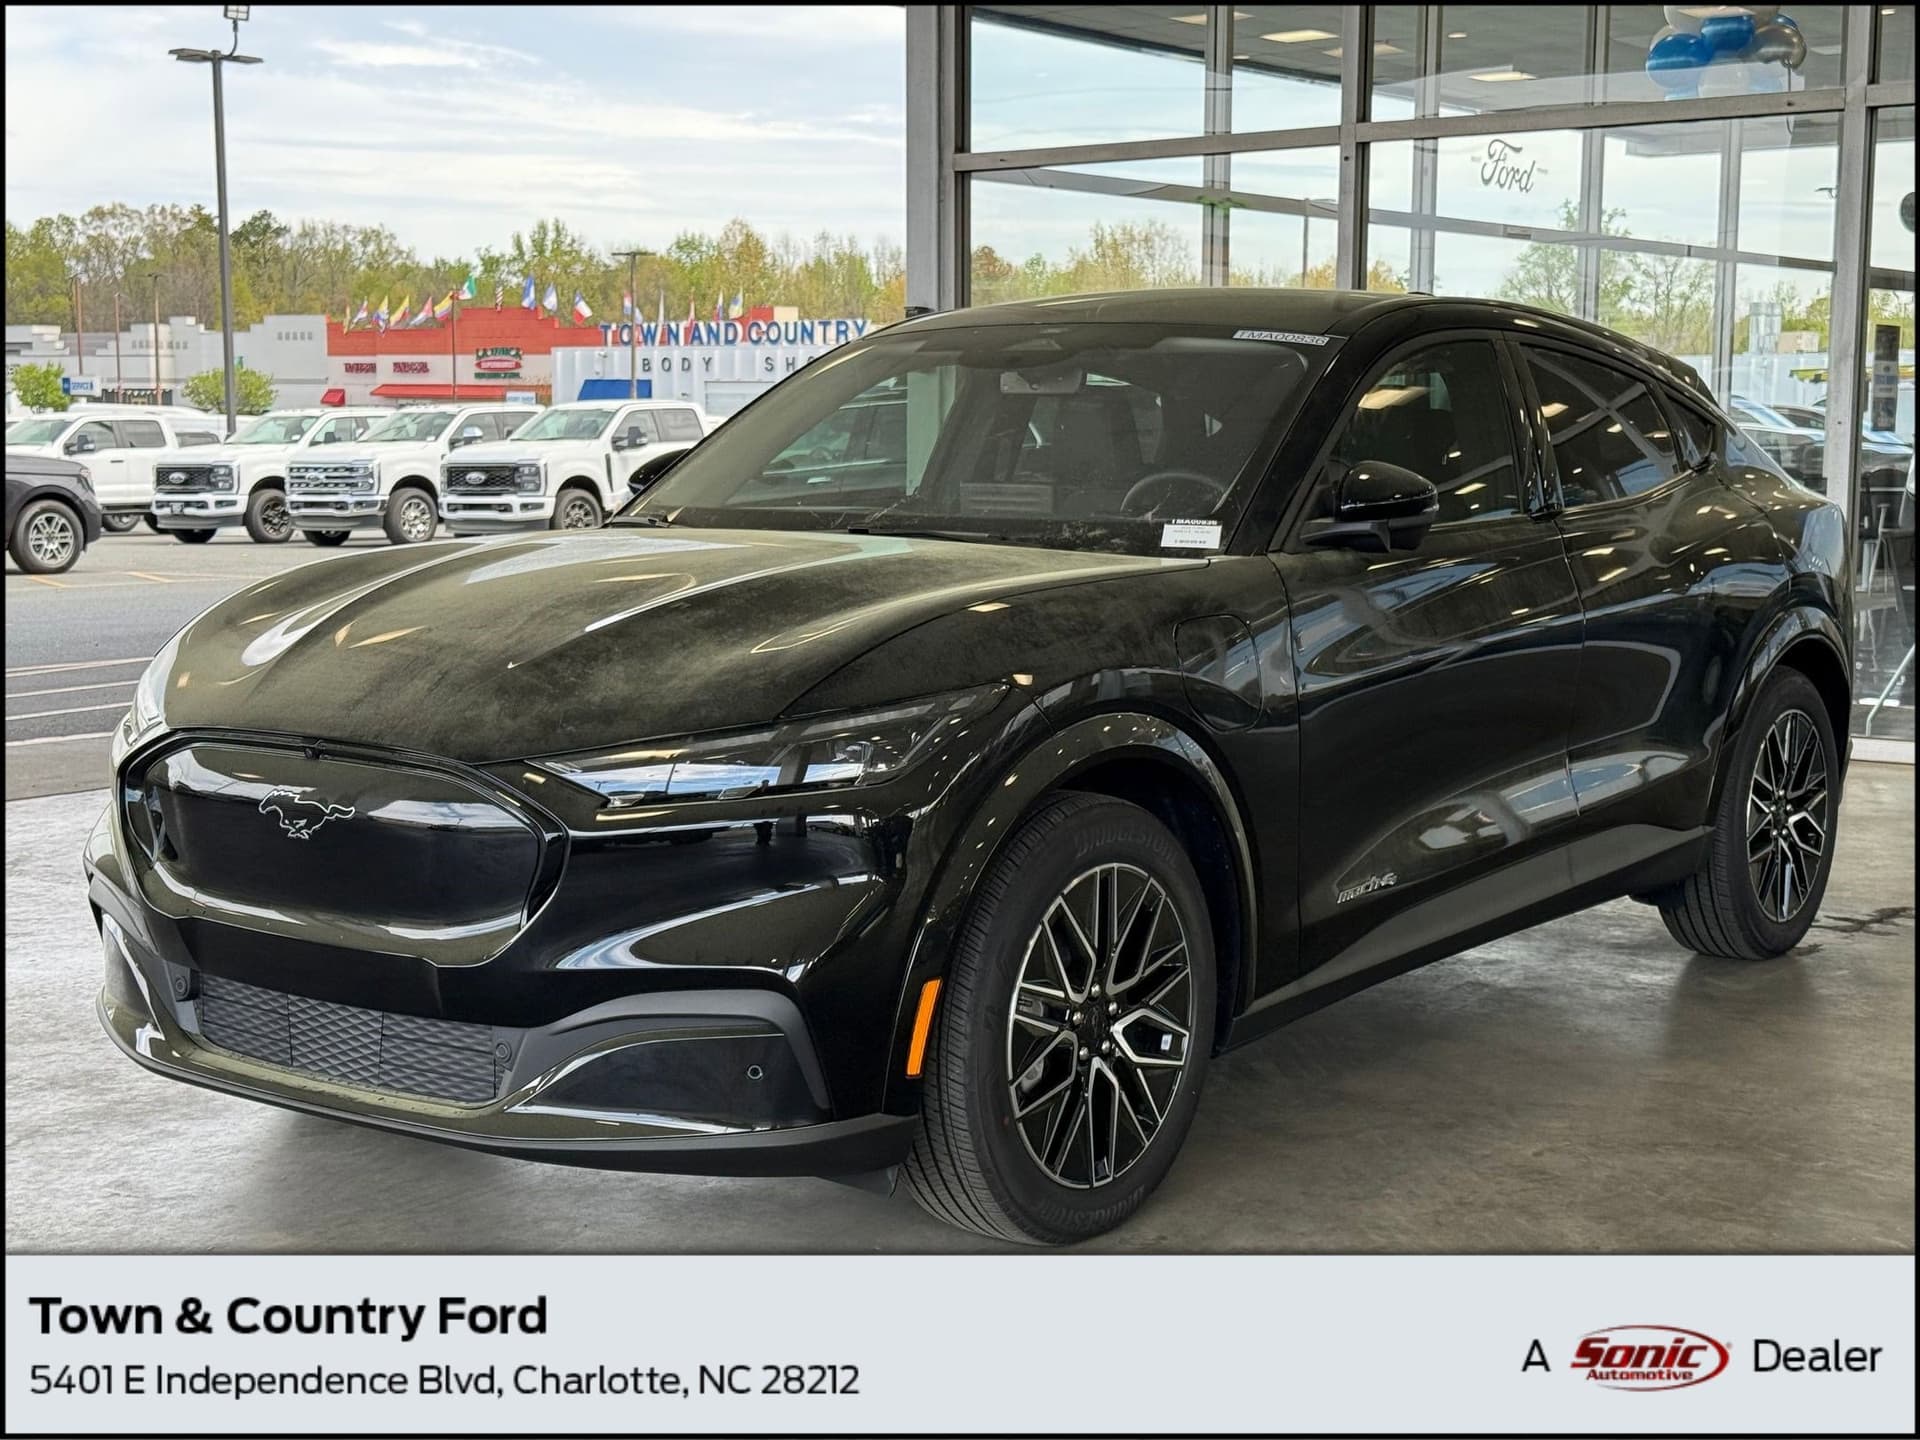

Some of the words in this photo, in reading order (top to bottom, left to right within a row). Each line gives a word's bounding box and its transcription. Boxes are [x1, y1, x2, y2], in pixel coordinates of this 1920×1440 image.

[1481, 139, 1536, 194] Ford
[599, 323, 679, 346] TOWN
[690, 322, 738, 345] AND
[748, 320, 867, 345] COUNTRY
[641, 357, 712, 372] BODY
[764, 355, 815, 372] SH
